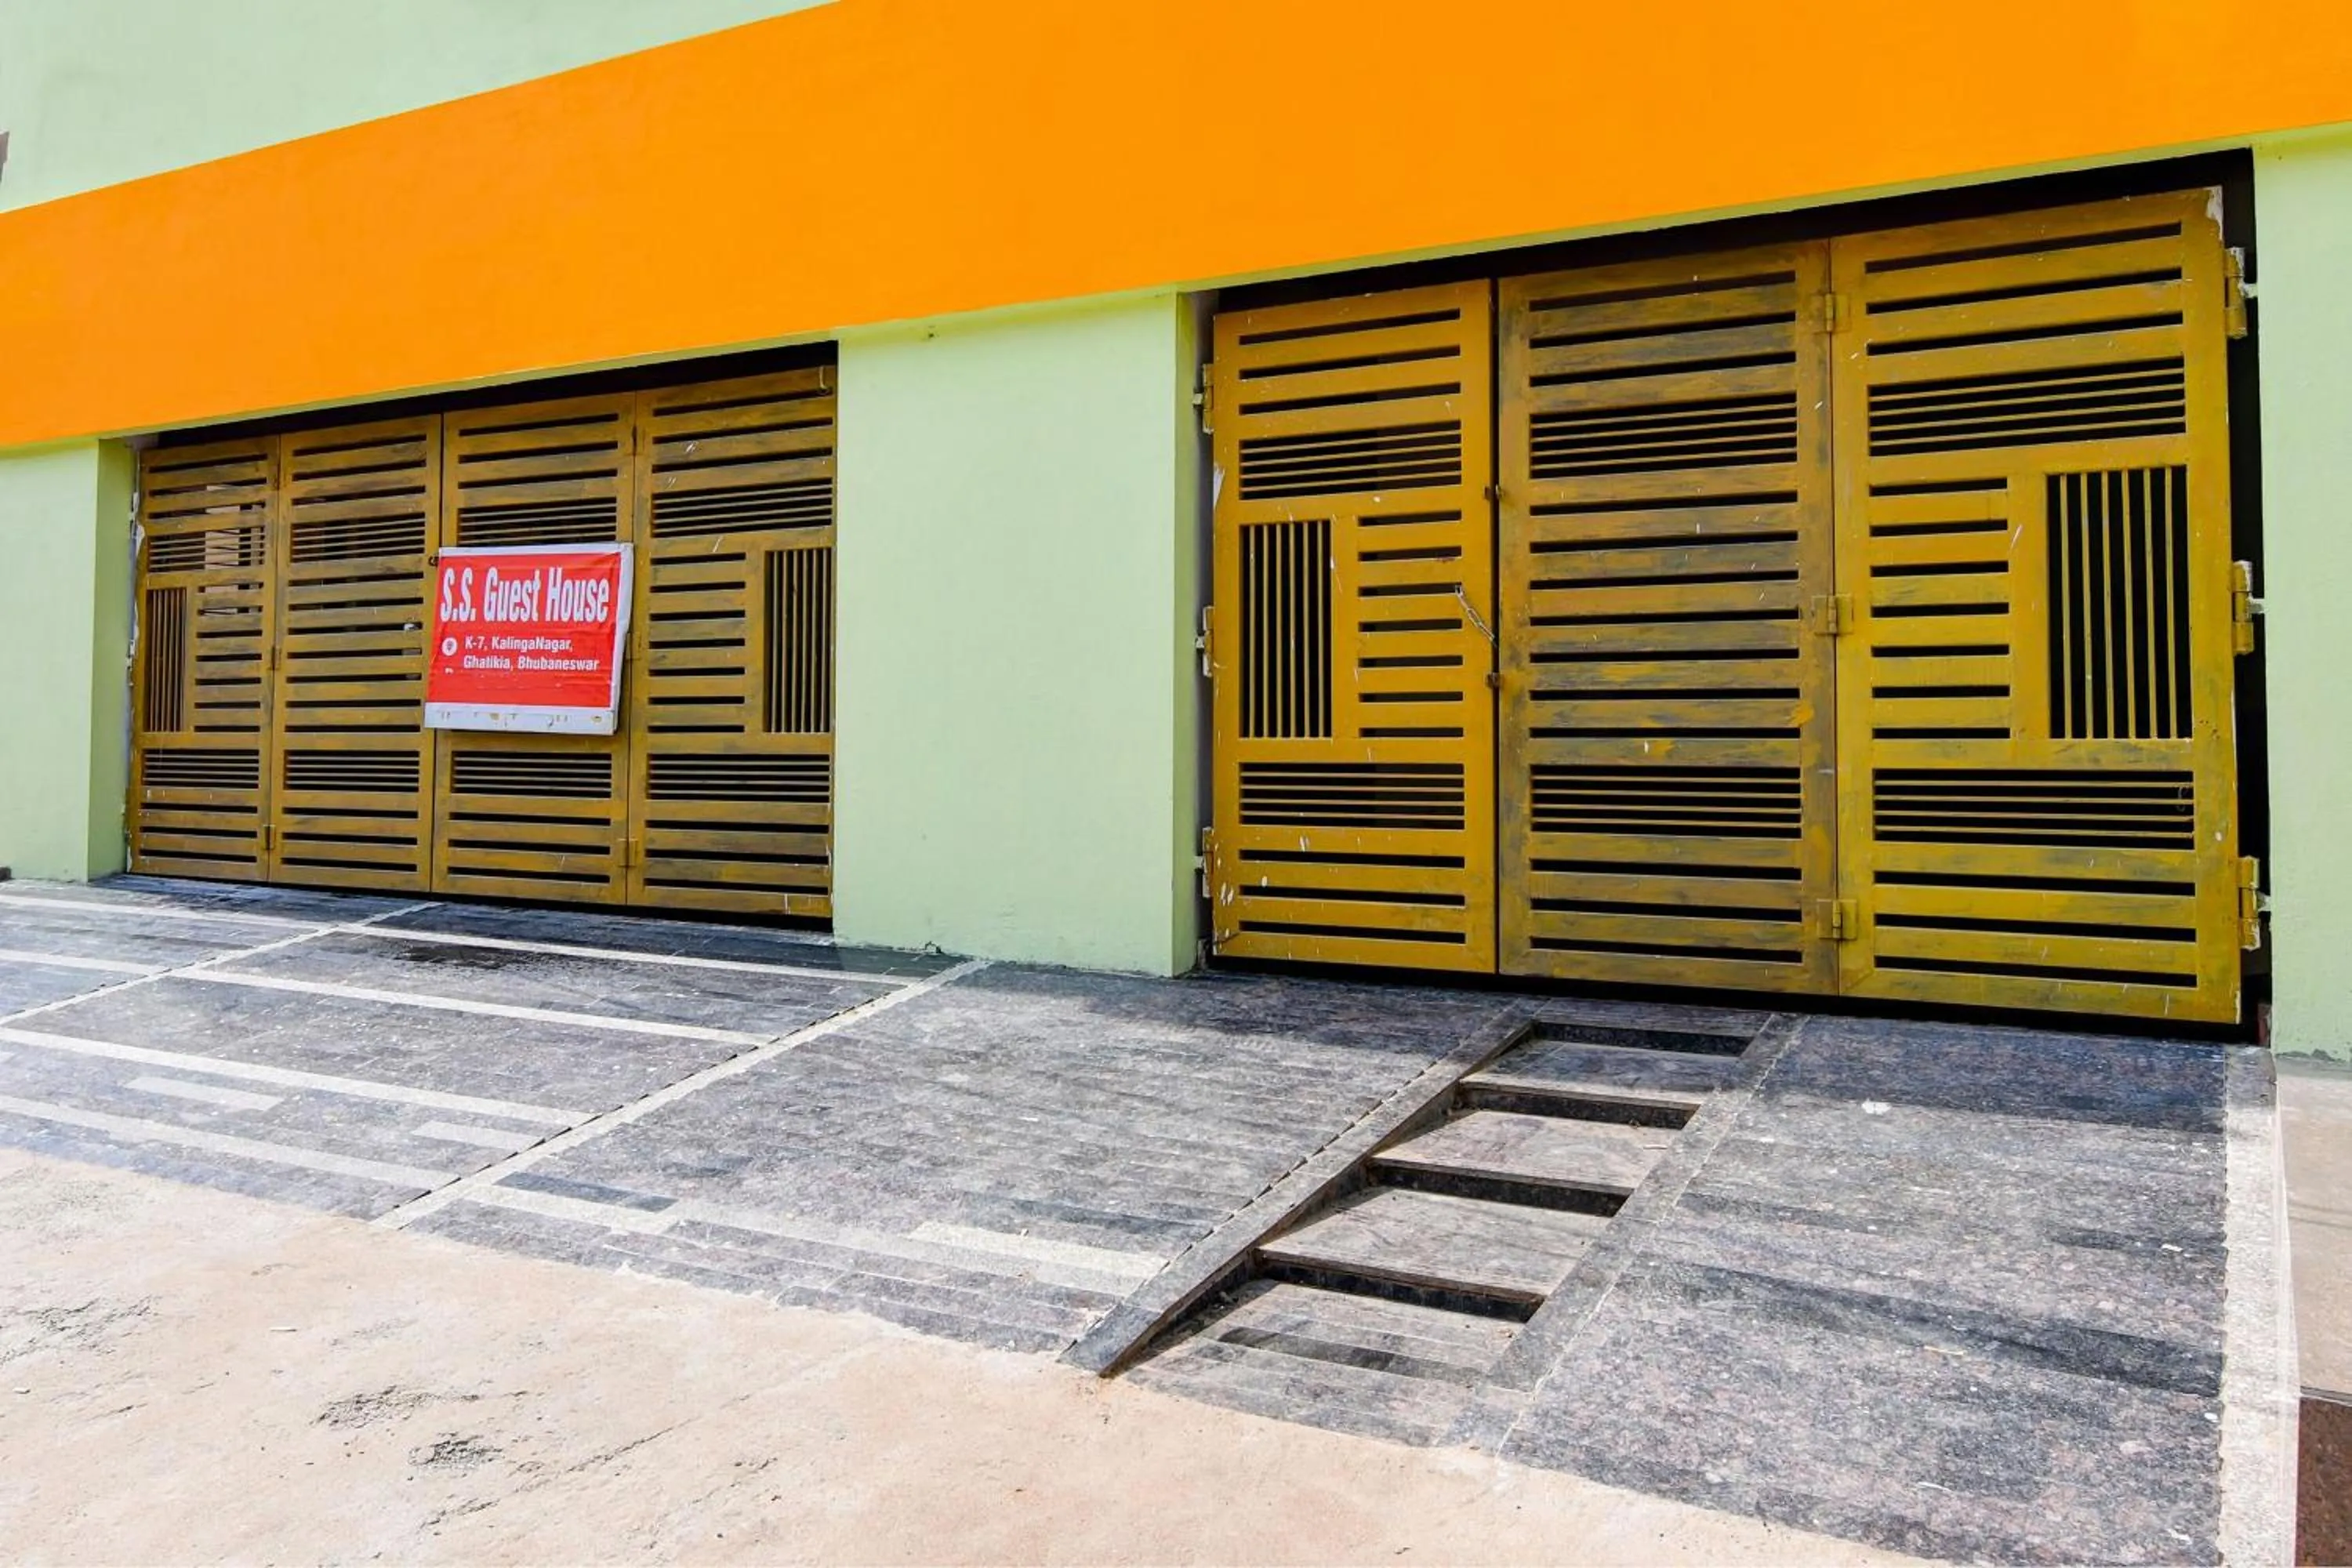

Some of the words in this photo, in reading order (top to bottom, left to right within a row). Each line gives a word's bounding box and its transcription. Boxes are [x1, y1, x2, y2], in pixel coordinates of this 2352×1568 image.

[440, 567, 477, 622] S.S.
[483, 567, 541, 622] Guest
[545, 567, 609, 622] House
[517, 655, 599, 672] Bhubaneswar
